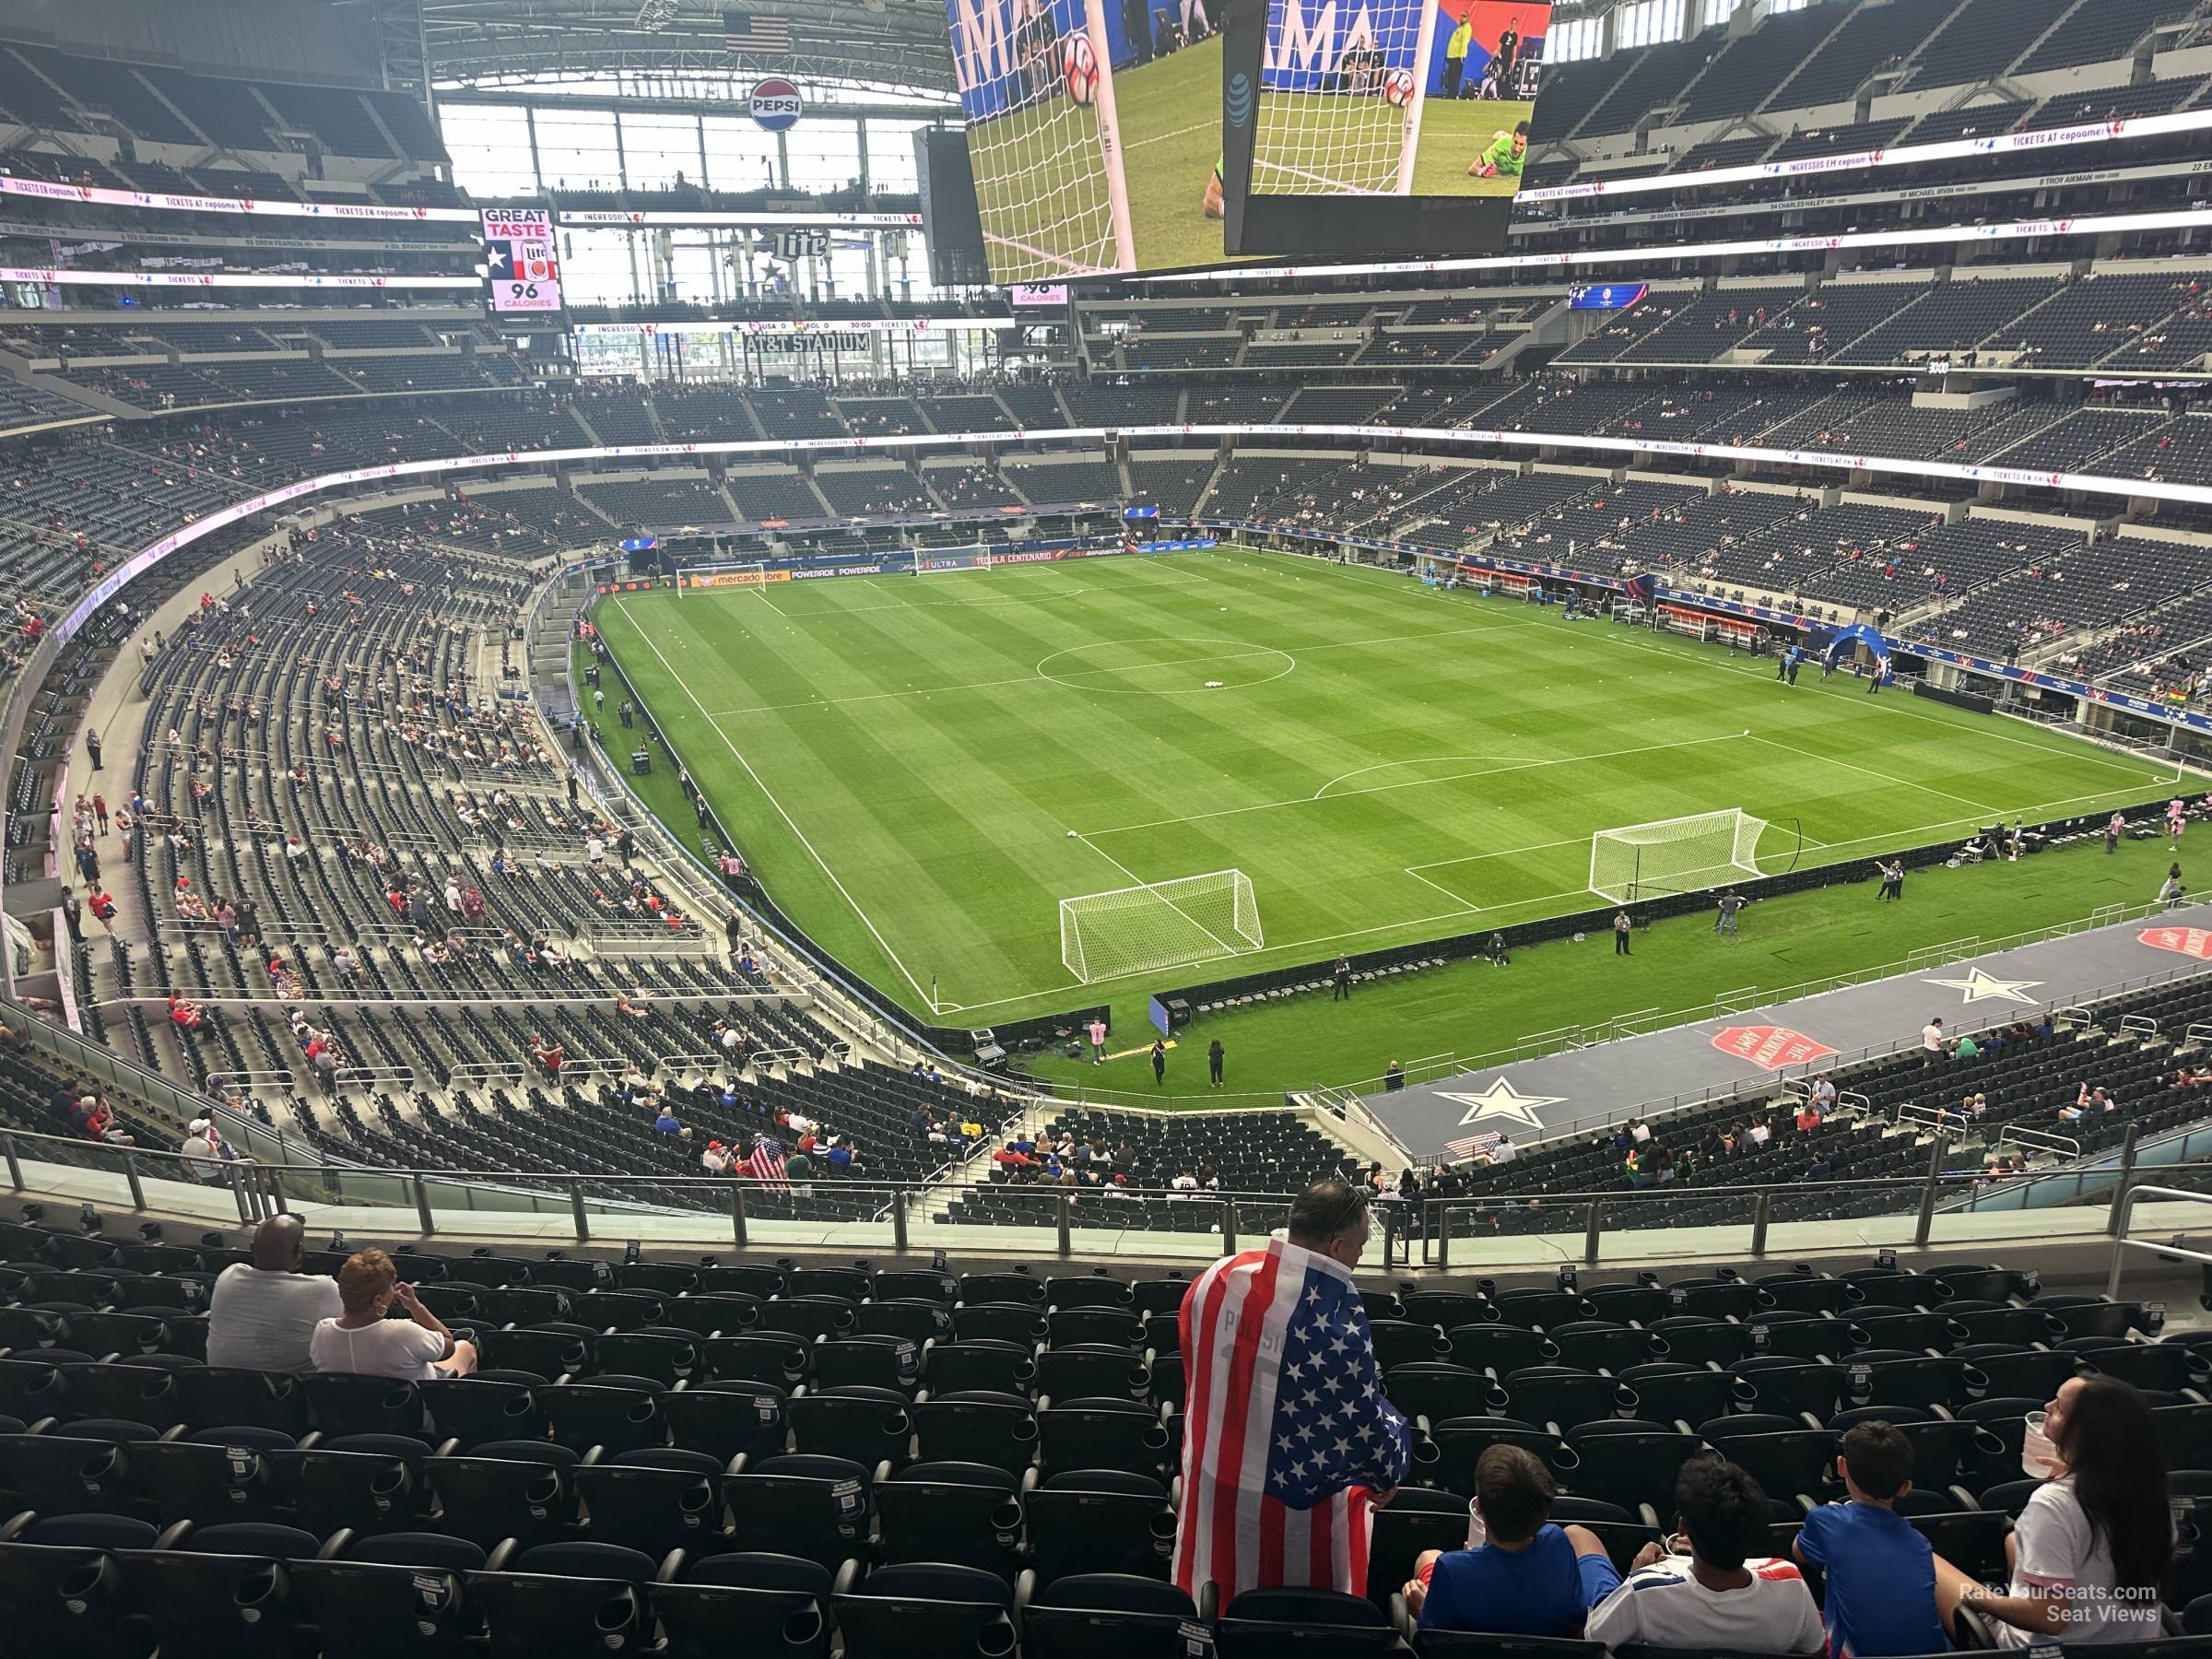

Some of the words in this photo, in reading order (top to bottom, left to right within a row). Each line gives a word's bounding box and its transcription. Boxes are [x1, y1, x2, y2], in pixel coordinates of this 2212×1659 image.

[753, 100, 799, 112] PEPSI
[2013, 134, 2045, 147] TICKETS
[2047, 134, 2057, 143] AT
[1789, 160, 1825, 172] INGRESSOS
[1826, 159, 1837, 168] EM
[2192, 163, 2202, 171] 22
[2045, 176, 2065, 185] TROY
[2065, 174, 2093, 183] AIKMAN
[15, 182, 40, 194] TICKETS
[1534, 187, 1556, 198] TICKETS
[1908, 189, 1936, 198] MICHAEL
[1936, 187, 1954, 195] IRVIN
[165, 197, 194, 208] TICKETS
[195, 199, 204, 208] AT
[1778, 201, 1805, 210] CHARLES
[1806, 199, 1825, 207] HALEY
[335, 206, 364, 216] TICKETS
[365, 207, 375, 216] EN
[485, 209, 546, 223] GREAT
[1679, 210, 1707, 218] WOODSON
[1569, 219, 1591, 228] JOHNSON
[2016, 224, 2048, 233] TICKETS
[488, 224, 547, 237] TASTE
[772, 232, 829, 263] Lite
[525, 247, 547, 261] Lite
[15, 271, 39, 280] TICKETS
[168, 276, 195, 284] TICKETS
[511, 283, 539, 300] 96
[504, 300, 552, 308] CALORIES
[745, 335, 789, 354] AT&T
[793, 334, 870, 352] STADIUM
[1928, 361, 1949, 374] 30:00
[1994, 471, 2020, 480] TICKETS
[930, 559, 958, 569] ULTRA
[975, 554, 1006, 565] TEQUILA
[1007, 552, 1052, 563] CENTENARIO
[791, 569, 835, 580] POWERADE
[839, 565, 881, 576] POWERADE
[1732, 1029, 1763, 1055] ARMY
[1754, 1028, 1795, 1065] SALVATION
[1785, 1042, 1812, 1061] THE
